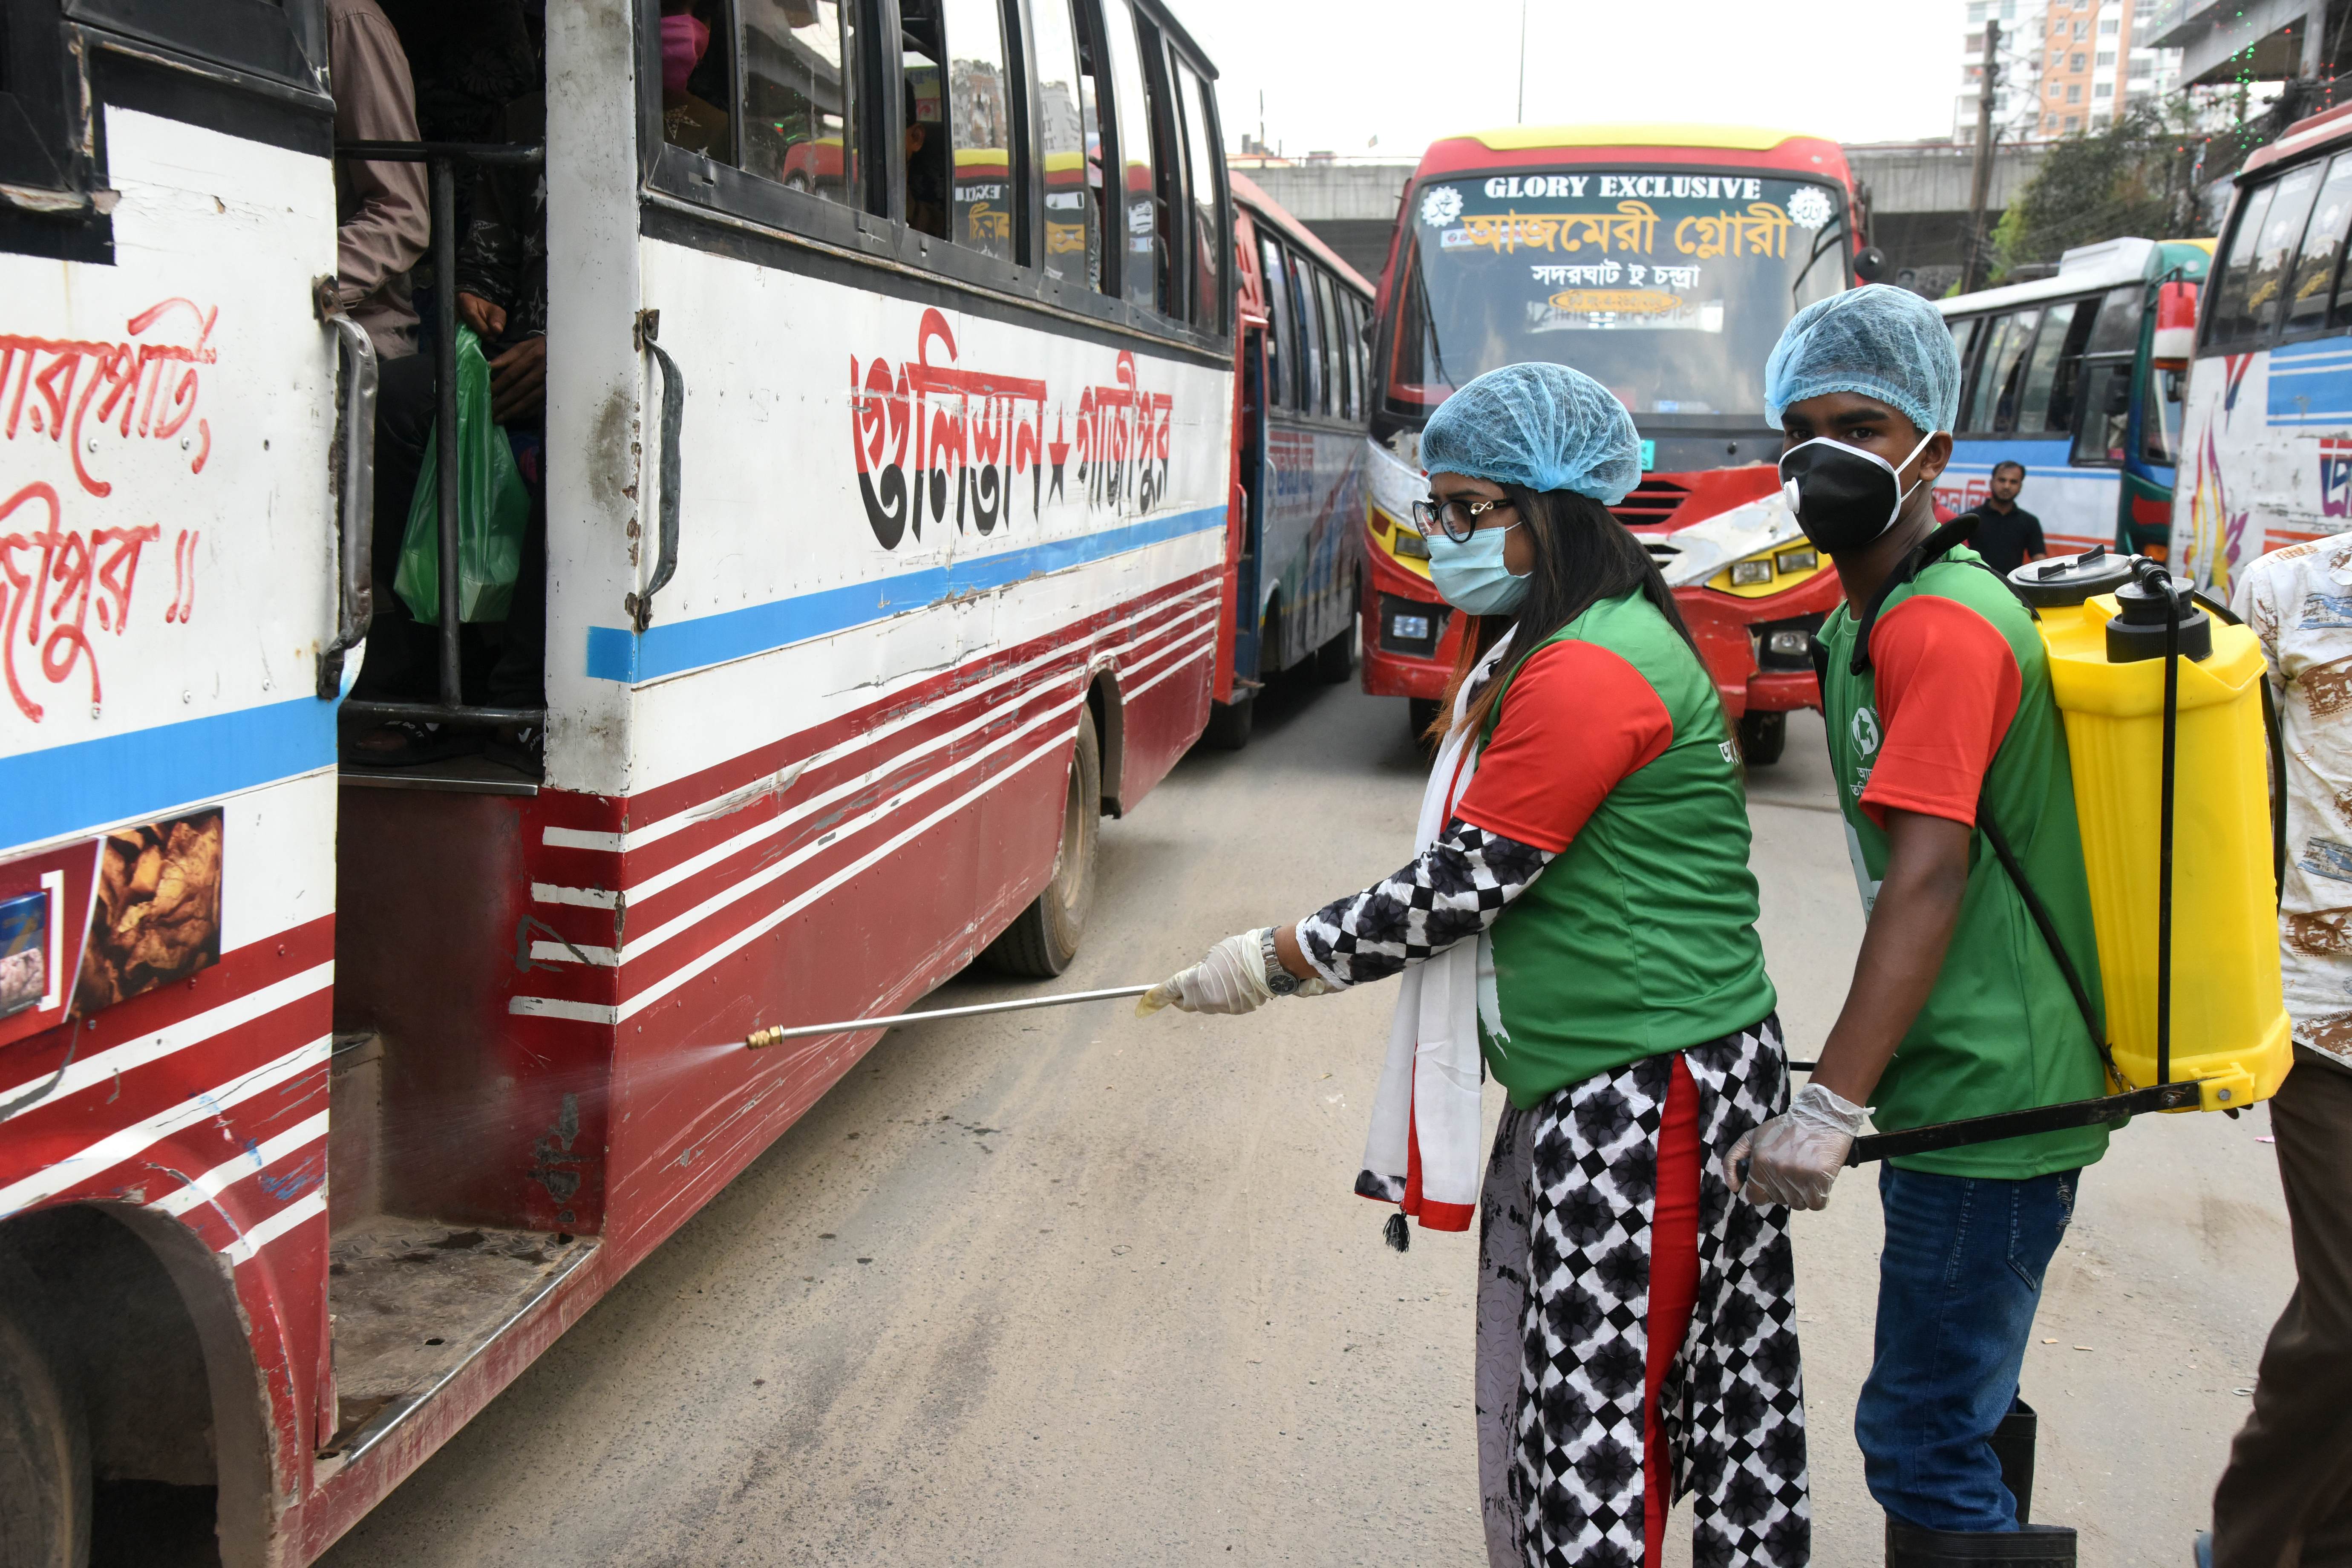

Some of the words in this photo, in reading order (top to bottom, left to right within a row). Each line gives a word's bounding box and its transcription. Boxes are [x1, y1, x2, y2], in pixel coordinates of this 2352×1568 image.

[1484, 176, 1589, 199] GLORY
[1599, 176, 1761, 200] EXCLUSIVE
[1460, 200, 1661, 255] আজমেরী
[1674, 202, 1794, 259] গ্লোরী
[1530, 258, 1623, 286] সদরঘাট
[1627, 262, 1648, 287] টু
[1651, 265, 1701, 289] চন্দ্রা
[1076, 349, 1173, 517] গাজীপুর
